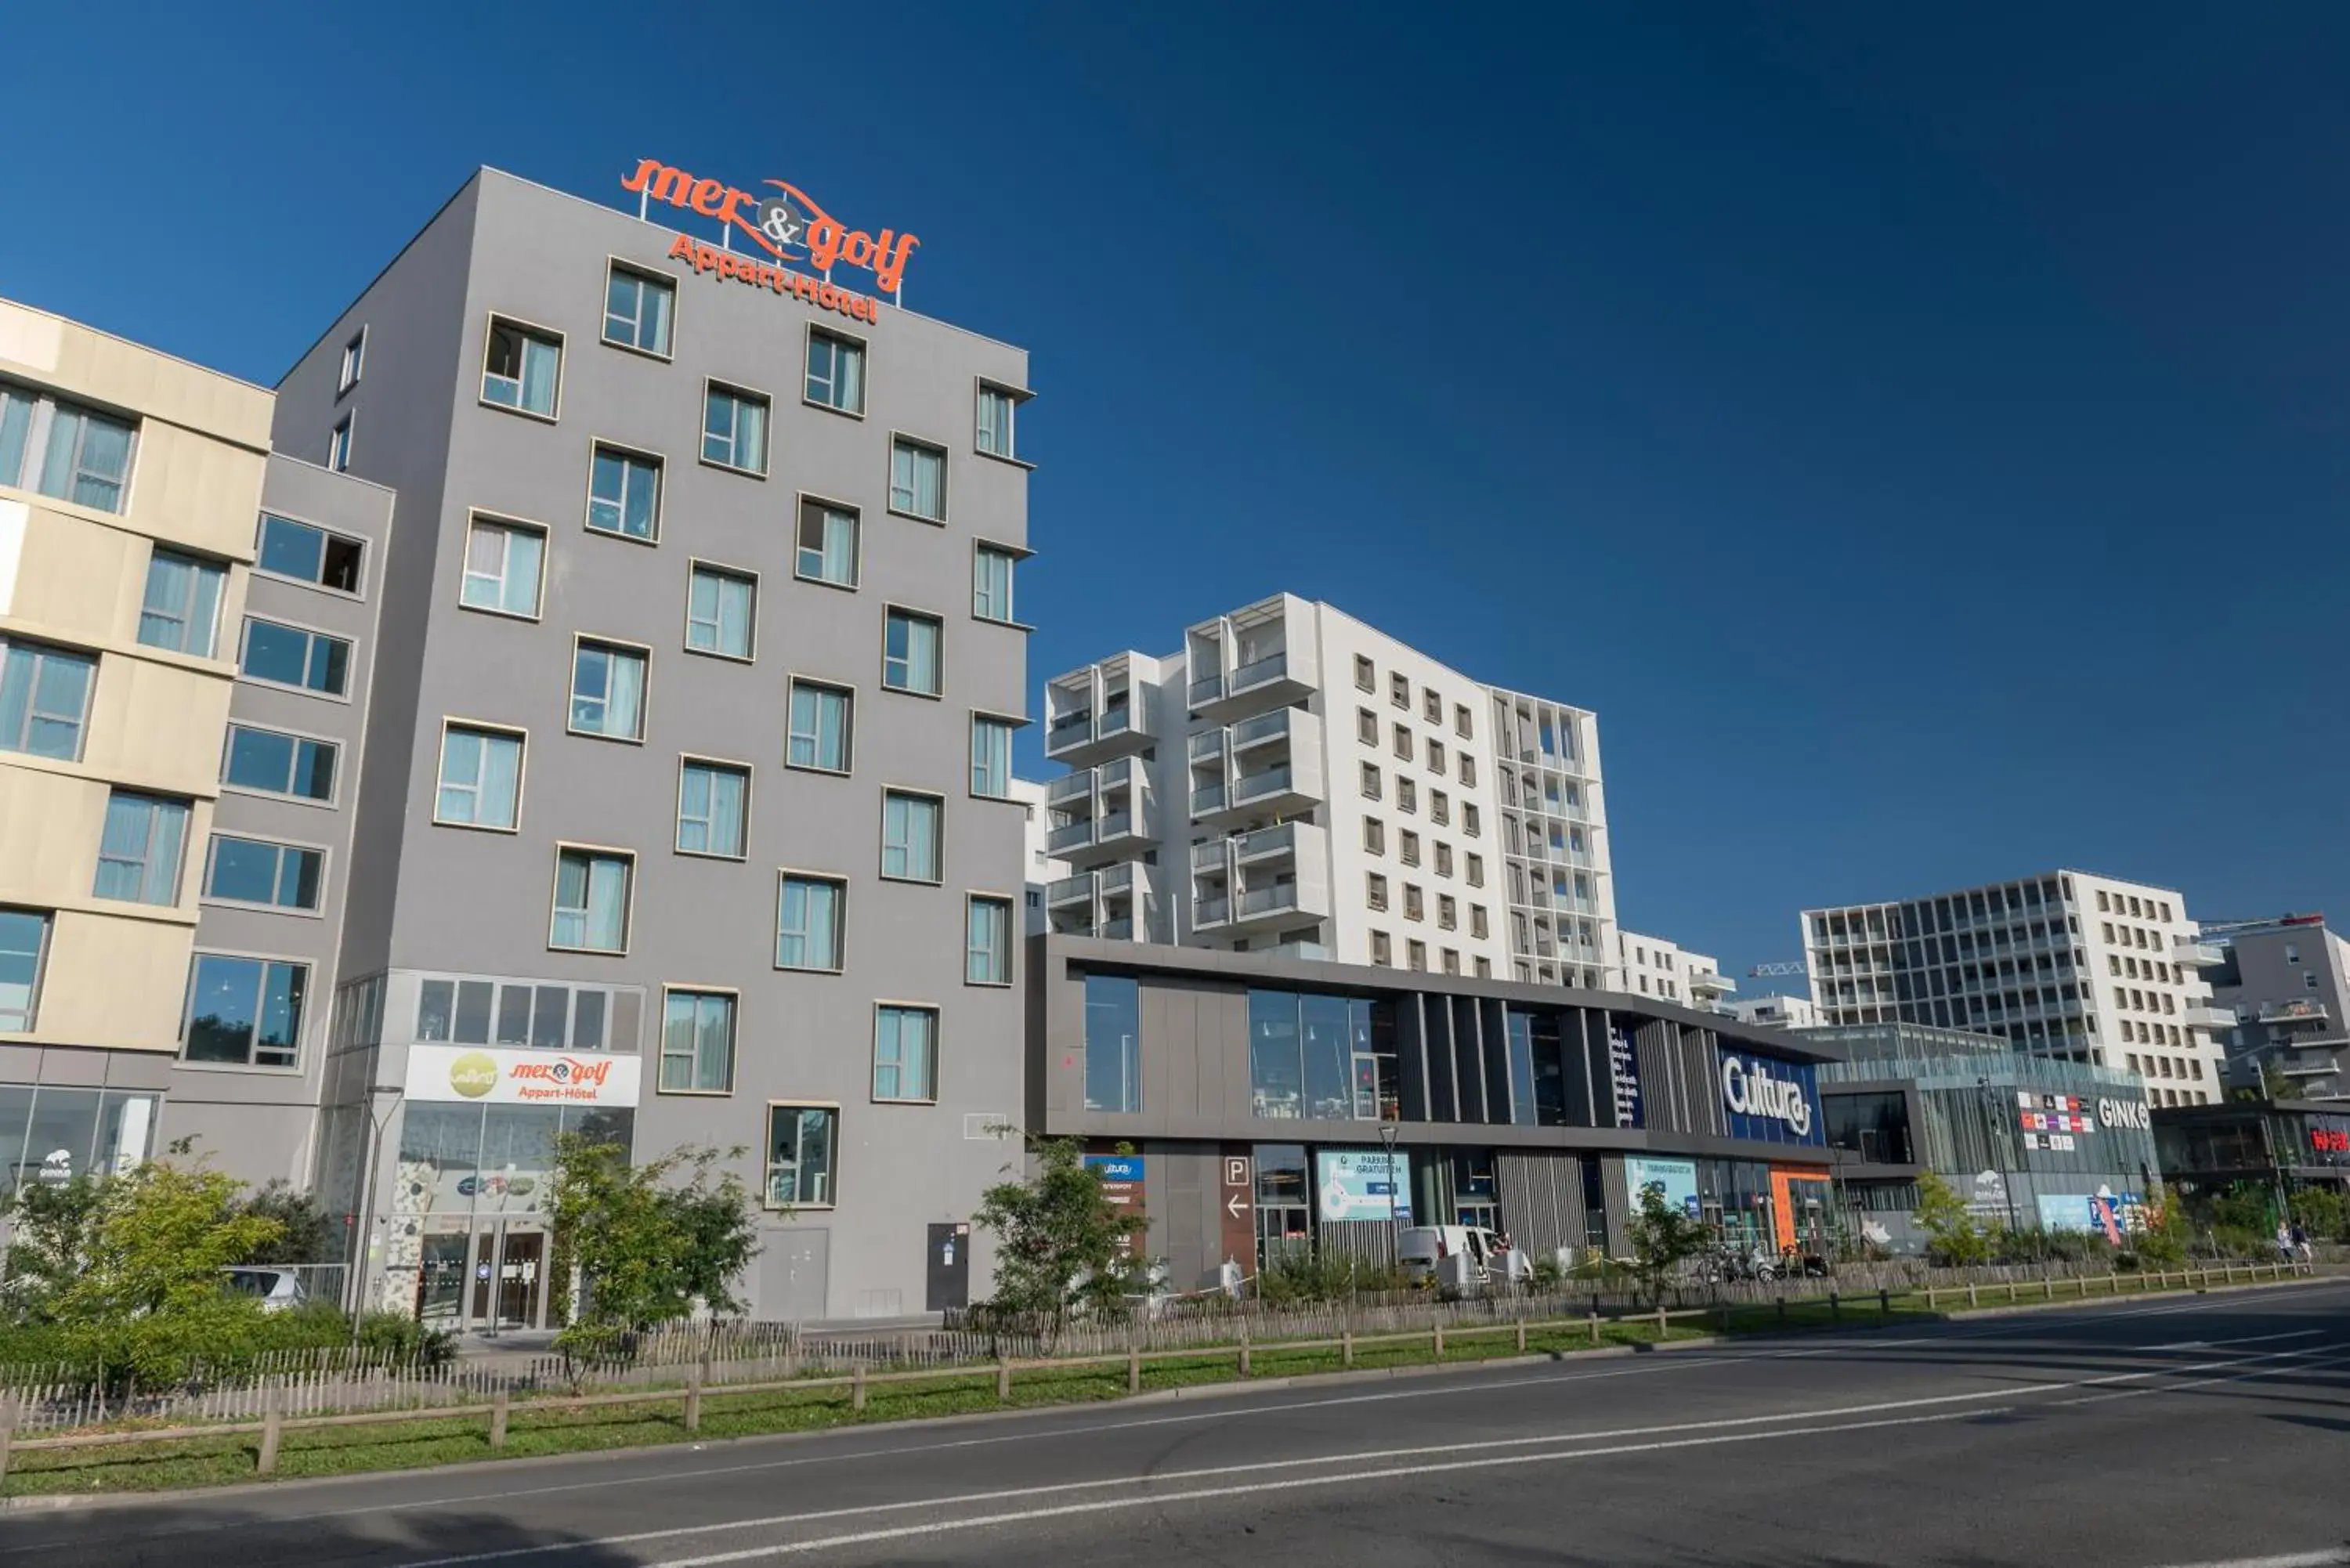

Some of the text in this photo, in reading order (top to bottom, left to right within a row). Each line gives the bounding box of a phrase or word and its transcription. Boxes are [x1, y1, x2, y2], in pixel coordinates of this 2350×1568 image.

[621, 159, 920, 293] mer & golf
[509, 1063, 551, 1079] mer
[572, 1060, 613, 1086] golf
[1723, 1057, 1811, 1136] Cultura
[2099, 1097, 2149, 1129] GINKO
[1231, 1162, 1243, 1180] P
